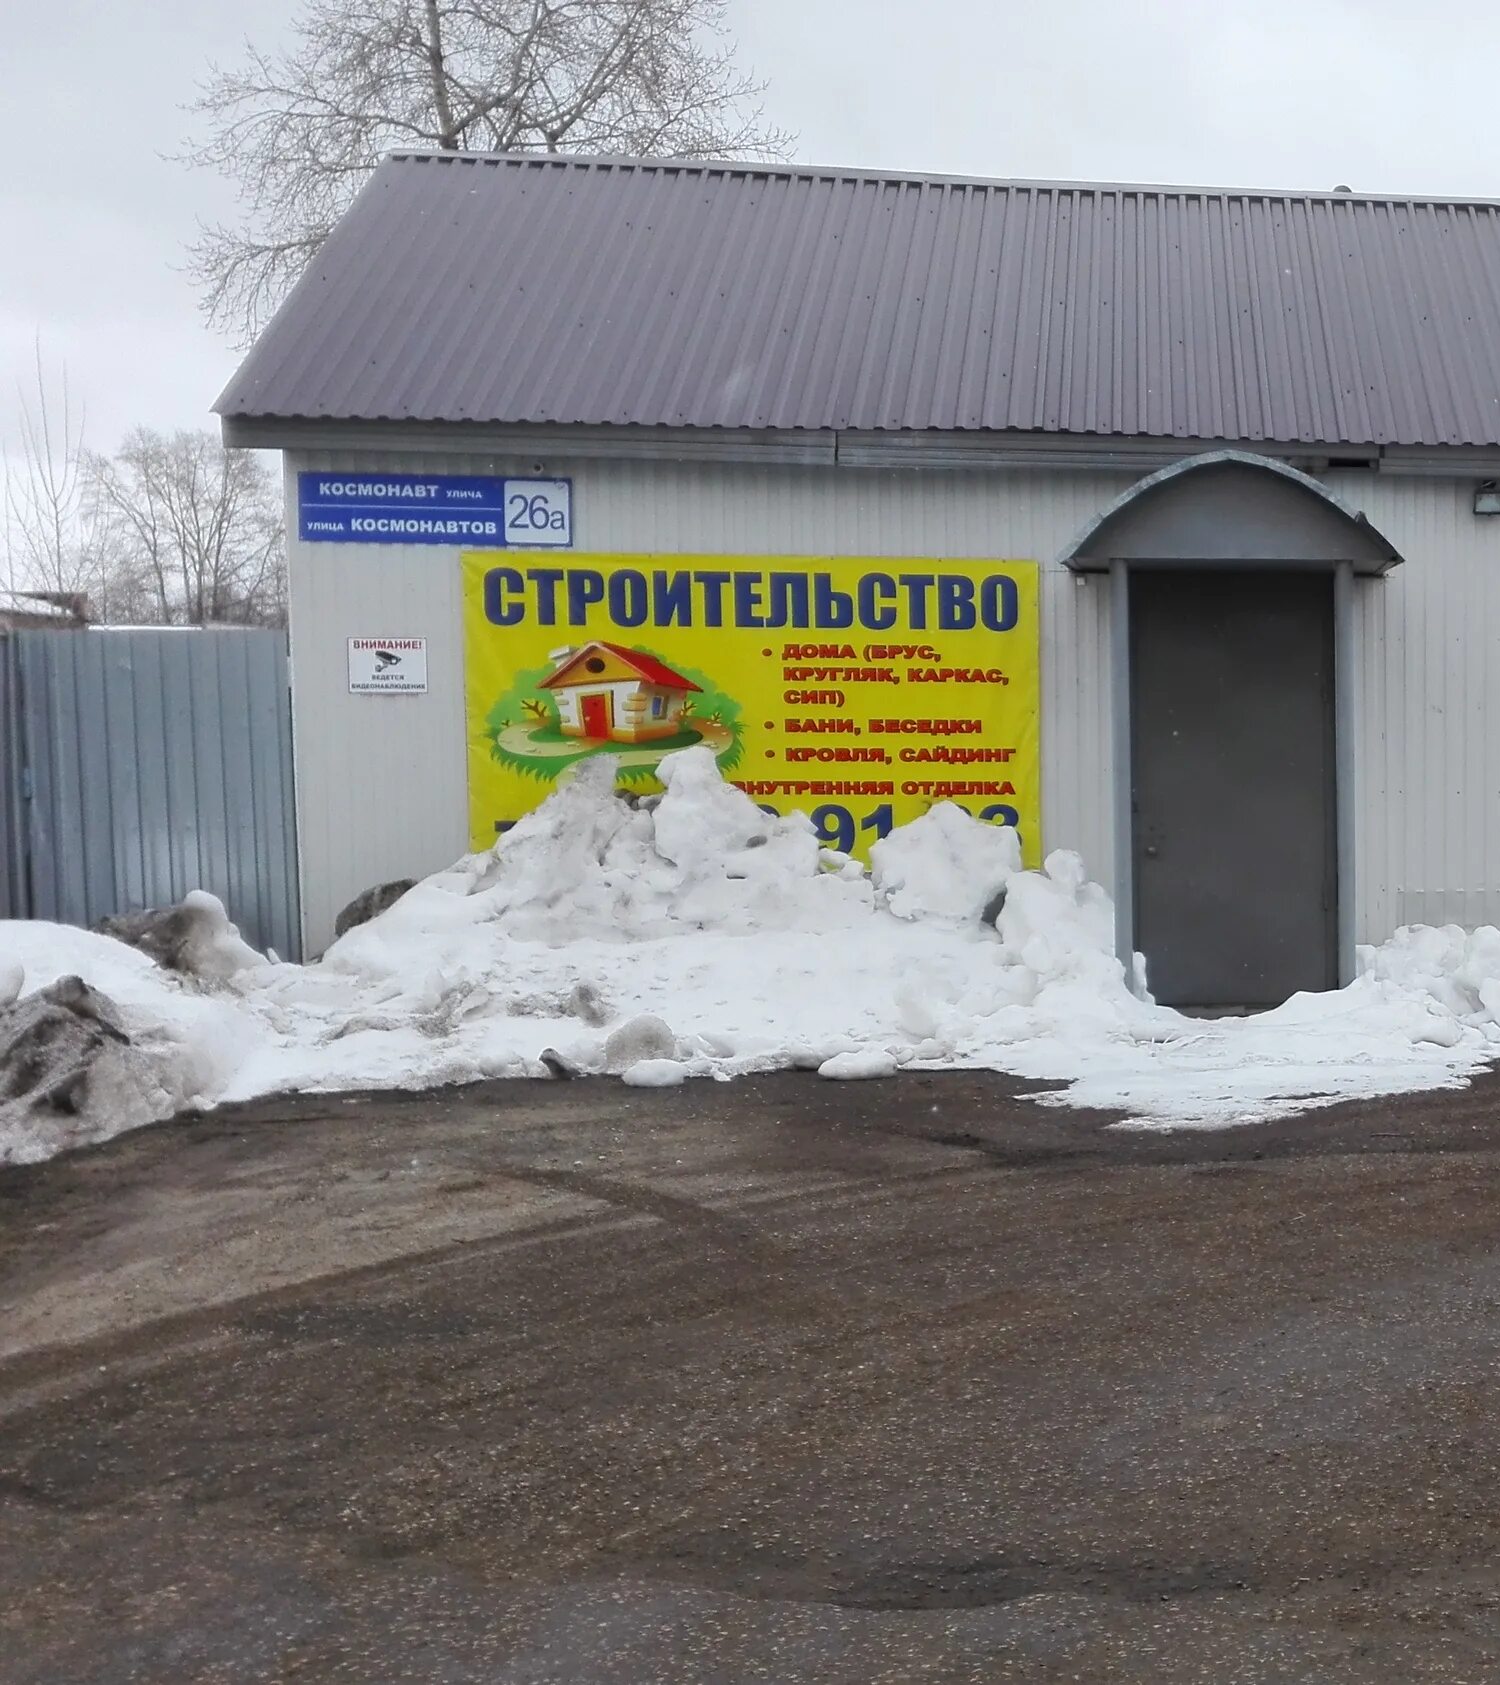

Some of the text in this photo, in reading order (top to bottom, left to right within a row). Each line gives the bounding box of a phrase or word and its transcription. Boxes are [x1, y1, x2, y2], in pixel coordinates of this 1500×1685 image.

[319, 482, 482, 499] КОСМОНАВТ УЛИЧА
[508, 494, 565, 530] 26а
[307, 518, 496, 534] УЛИЦА КОСМОНАВТОВ
[483, 567, 1019, 632] СТРОИТЕЛЬСТВО
[353, 640, 422, 649] ВНИМАНИЕ!
[782, 643, 941, 662] ДОМА (БРУС,
[783, 667, 1009, 685] КРУГЛЯК, КАРКАС,
[783, 690, 845, 707] СИП)
[784, 719, 982, 736] БАНИ, БЕСЕДКИ
[785, 745, 1016, 765] КРОВЛЯ, САЙДИНГ
[901, 781, 1016, 797] ОТДЕЛКА
